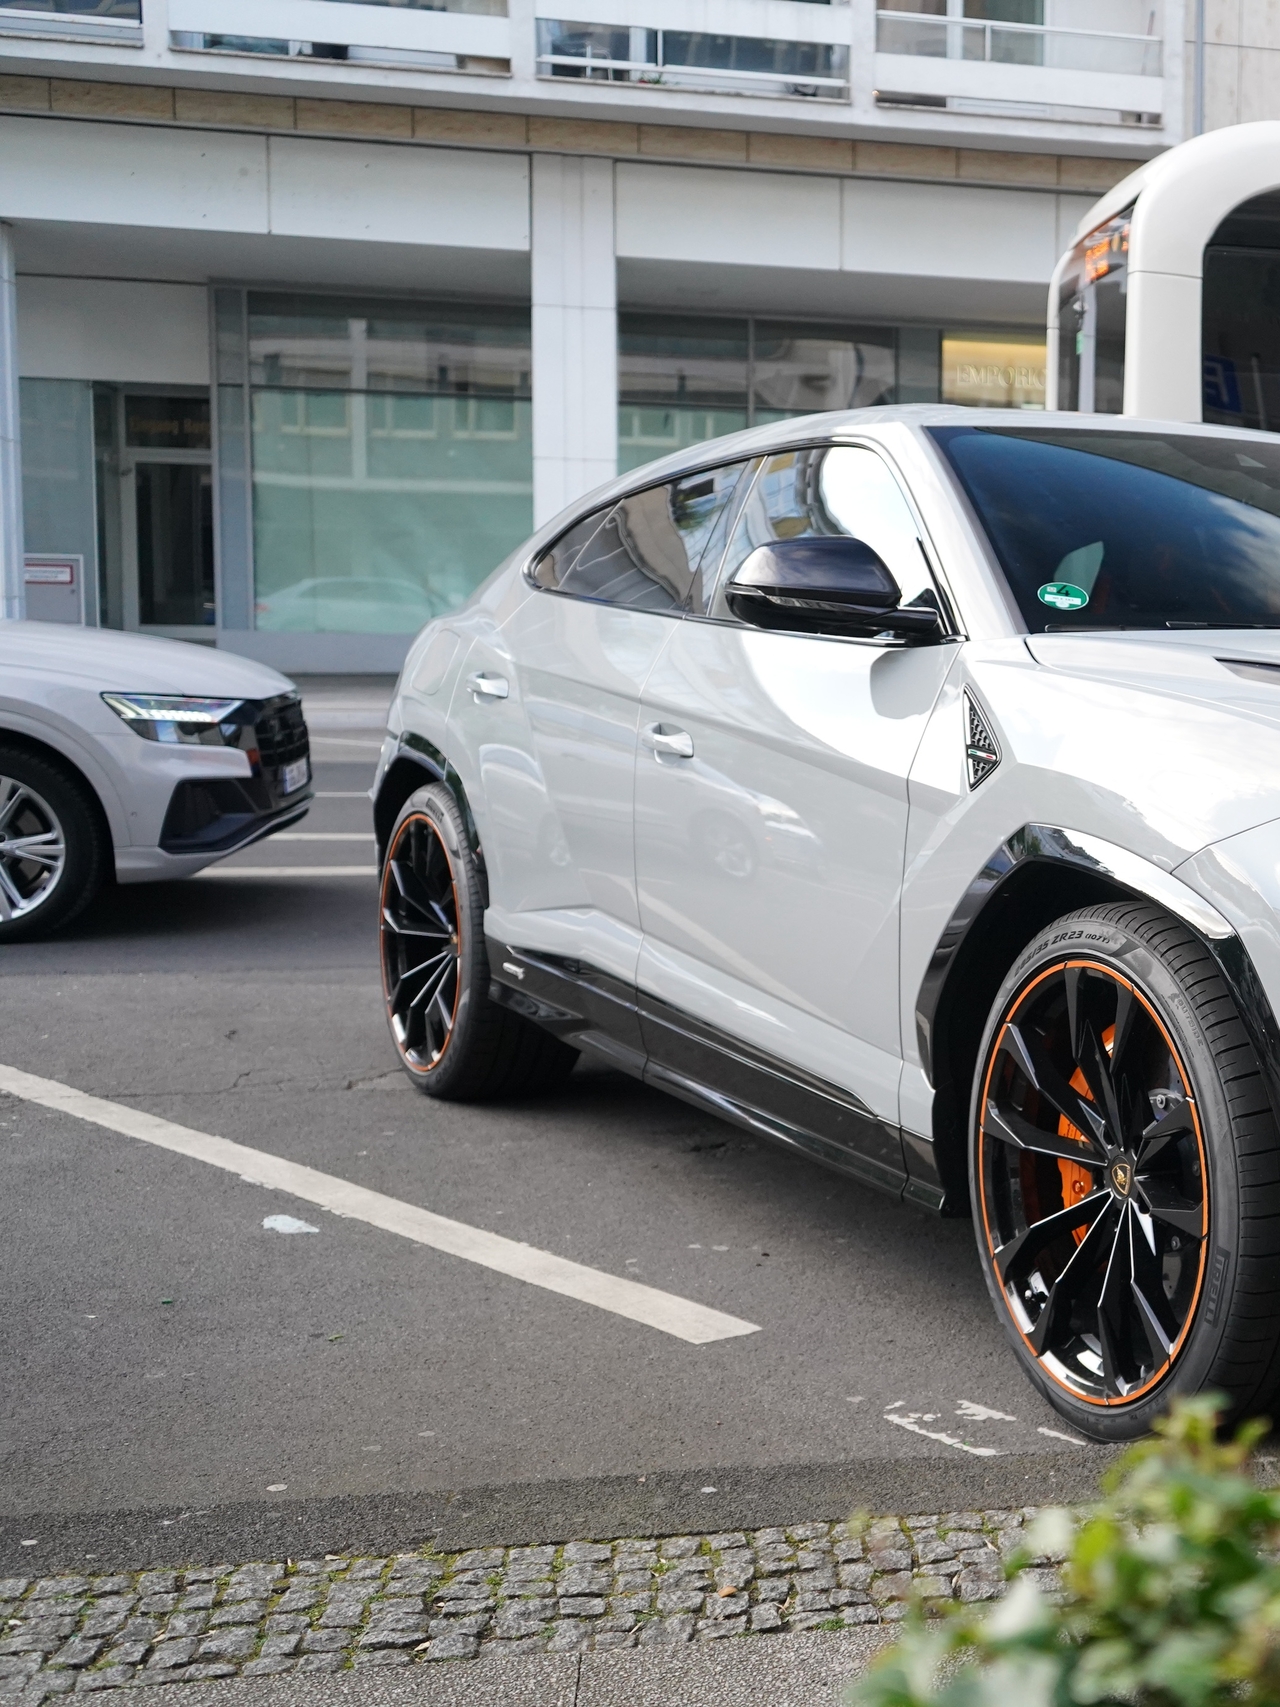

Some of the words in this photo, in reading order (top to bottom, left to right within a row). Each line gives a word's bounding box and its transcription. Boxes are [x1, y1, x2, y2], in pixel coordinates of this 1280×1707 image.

[1056, 584, 1071, 597] 4
[1050, 930, 1084, 945] ZR23
[1203, 1246, 1231, 1329] PIRELLI
